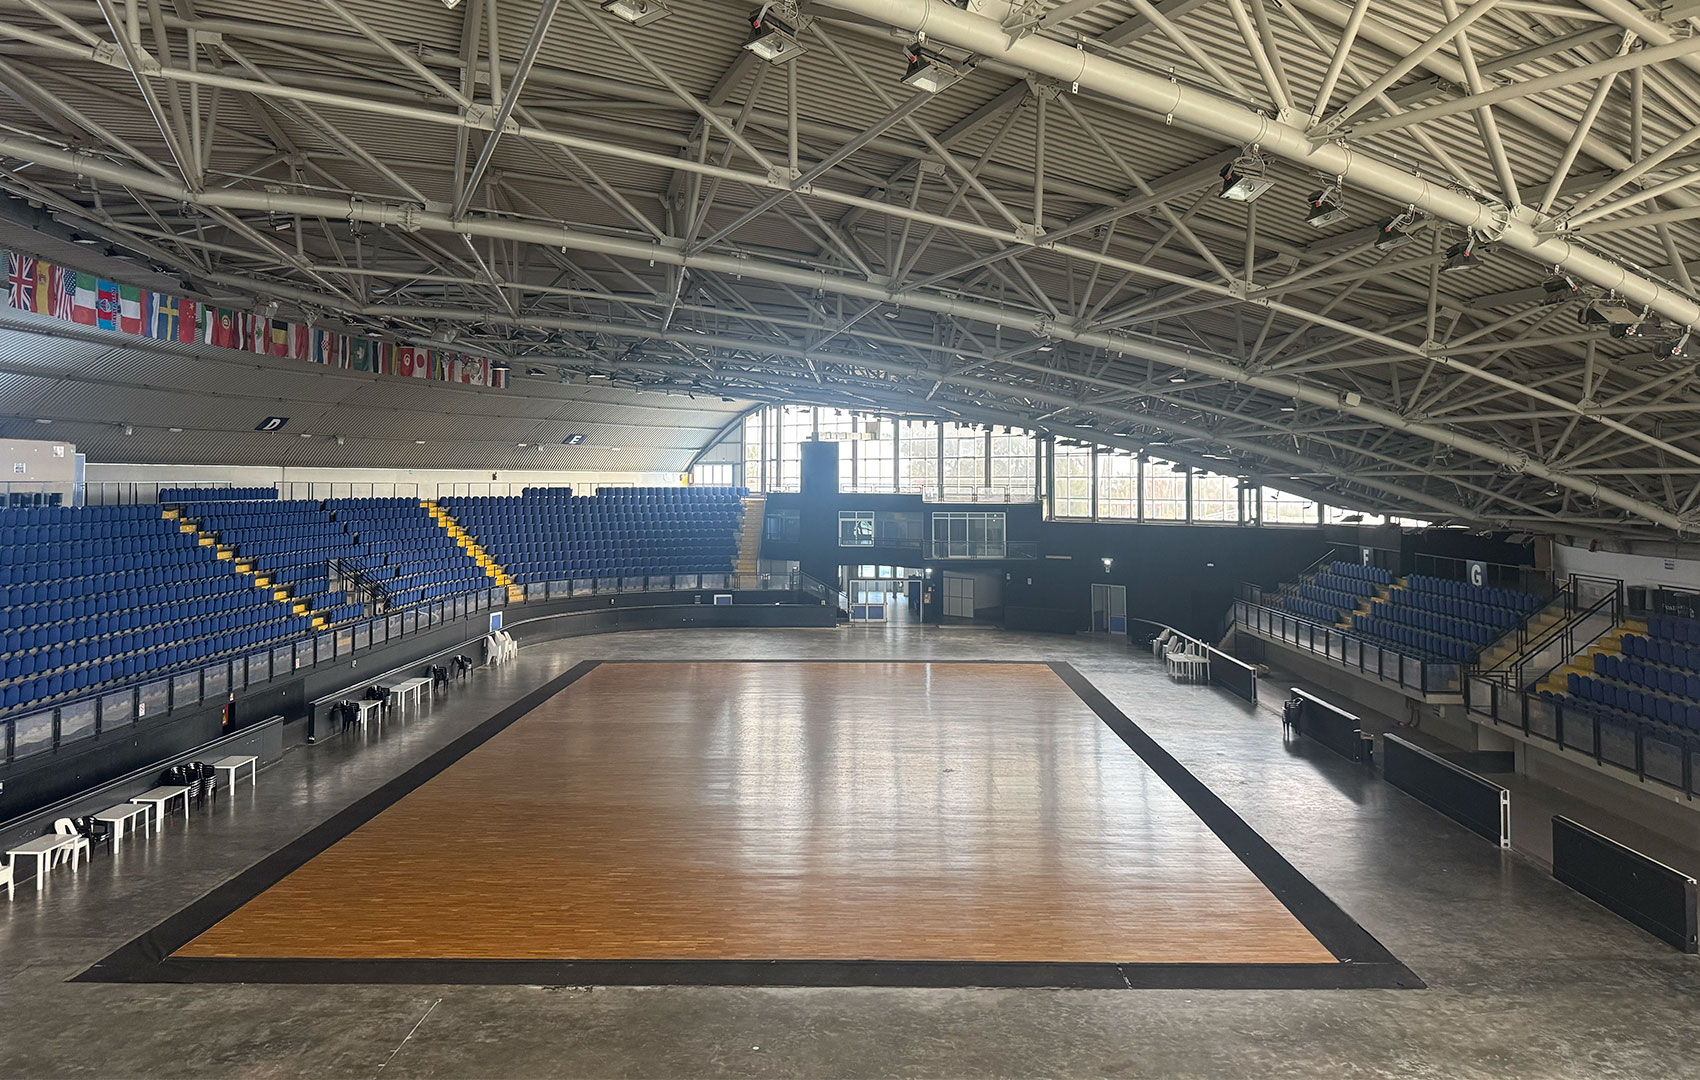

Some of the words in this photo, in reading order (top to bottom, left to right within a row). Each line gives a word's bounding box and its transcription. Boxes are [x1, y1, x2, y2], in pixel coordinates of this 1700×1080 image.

[263, 418, 280, 430] D
[569, 435, 582, 445] E
[1363, 549, 1369, 567] F
[1471, 564, 1482, 586] G
